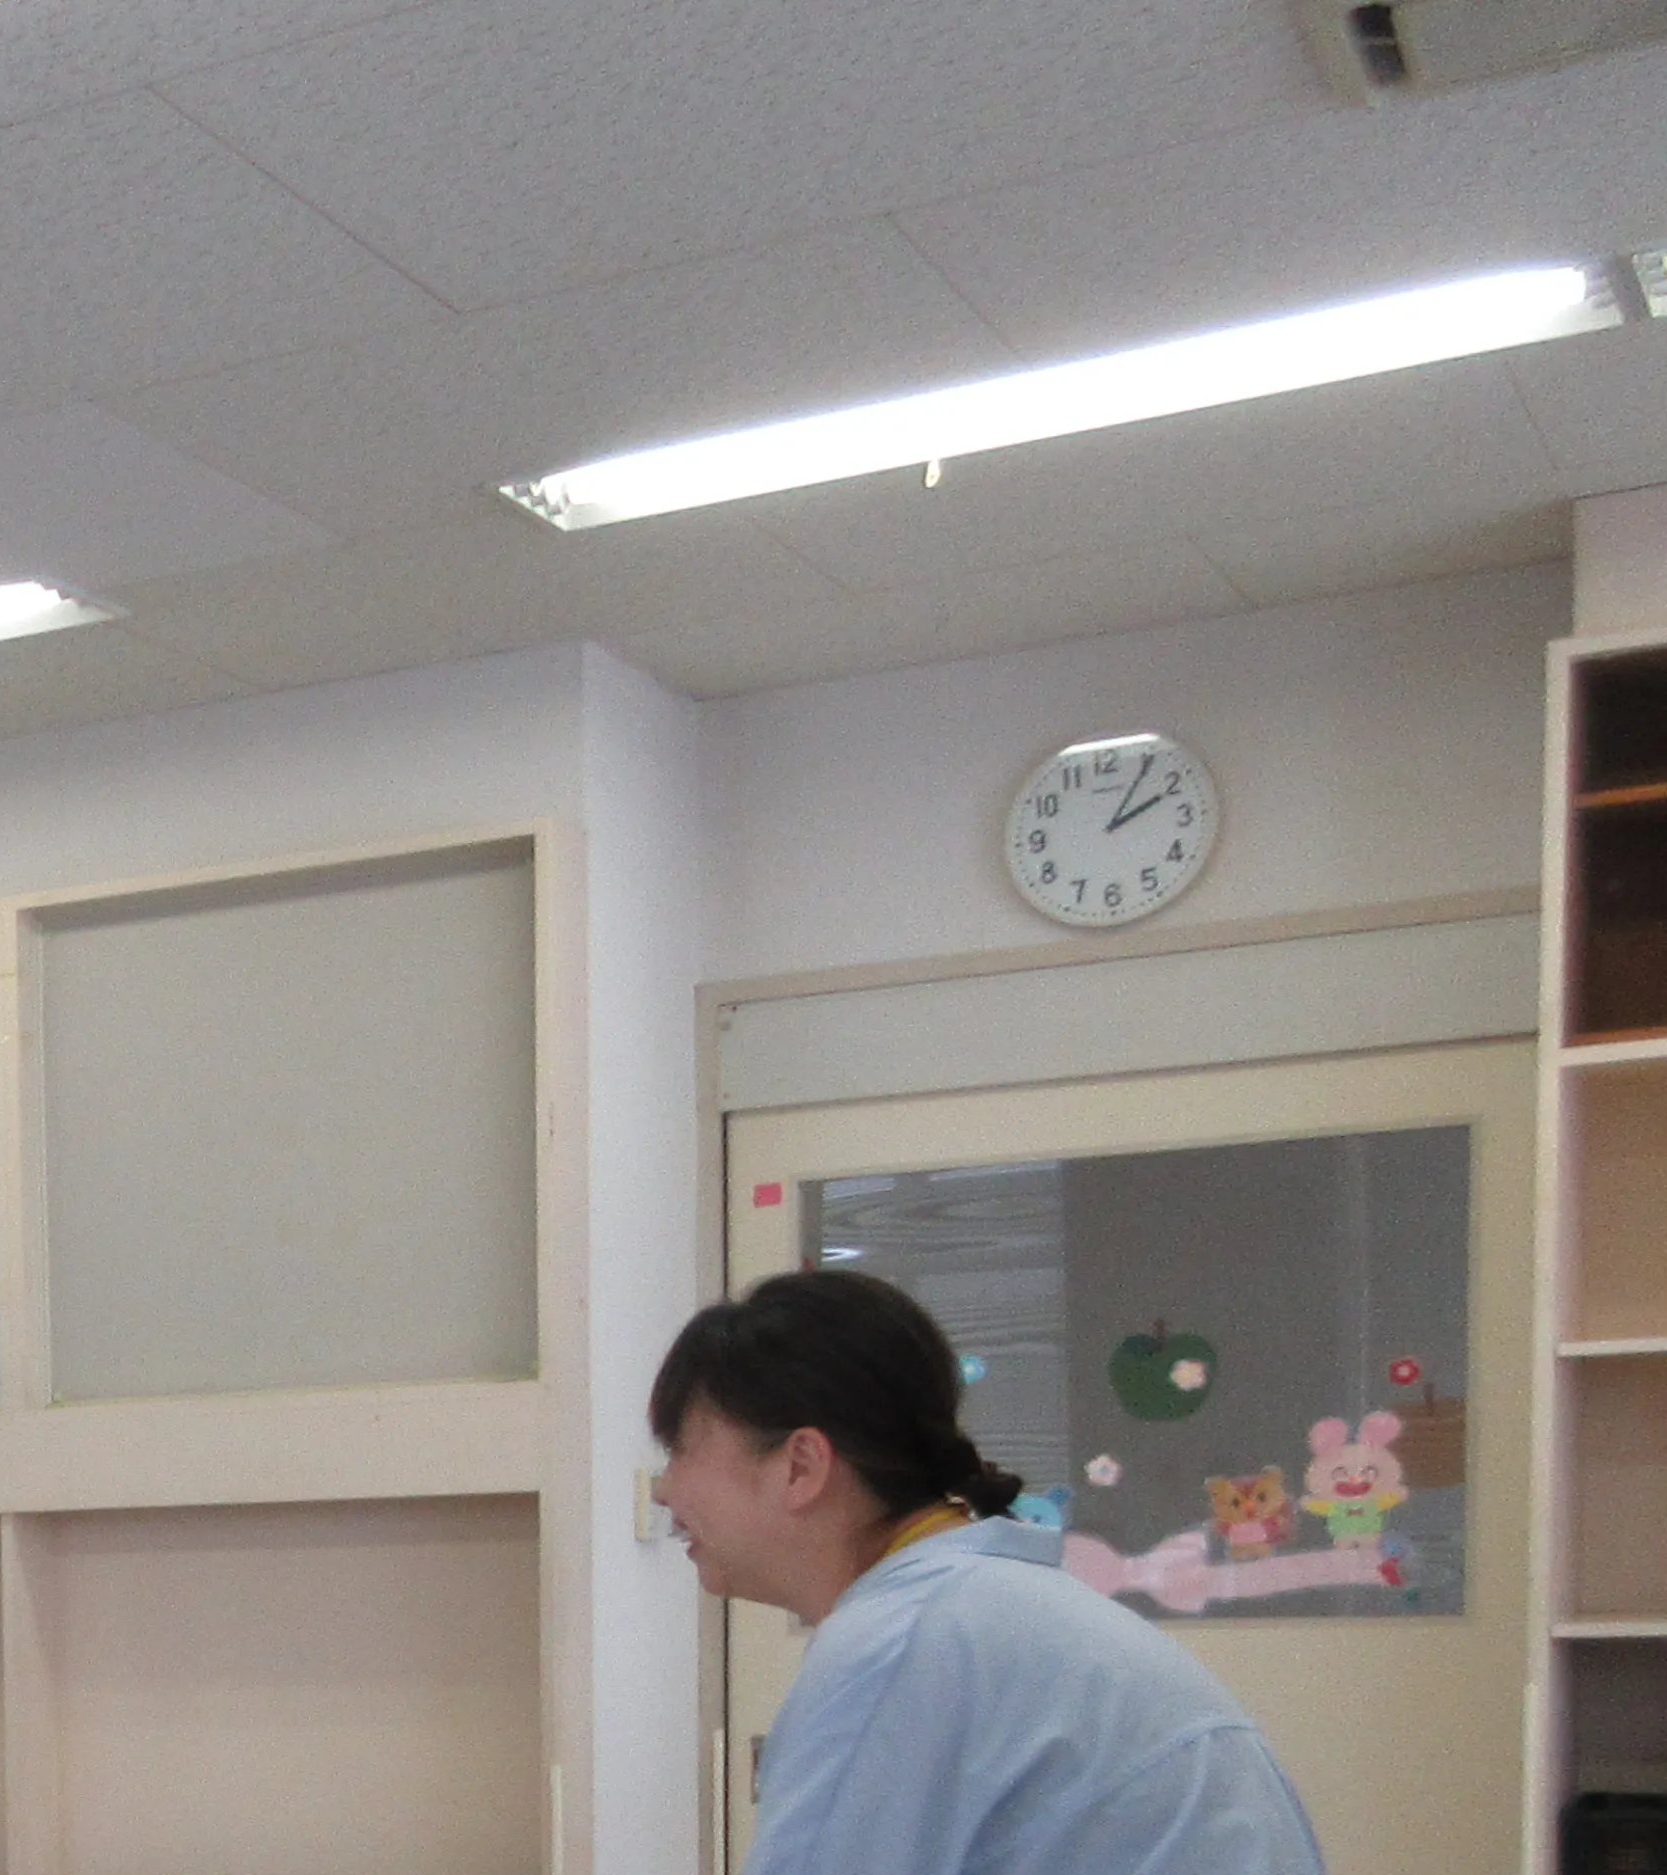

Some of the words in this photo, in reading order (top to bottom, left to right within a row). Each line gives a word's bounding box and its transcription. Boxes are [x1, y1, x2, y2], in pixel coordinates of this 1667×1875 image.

[1094, 749, 1117, 775] 12
[1063, 765, 1082, 790] 11
[1164, 771, 1181, 796] 2
[1035, 794, 1059, 818] 10
[1176, 803, 1194, 827] 3
[1028, 830, 1046, 853] 9
[1167, 839, 1184, 862] 4
[1041, 861, 1057, 884] 8
[1141, 867, 1159, 892] 5
[1070, 879, 1088, 903] 7
[1104, 883, 1123, 907] 6
